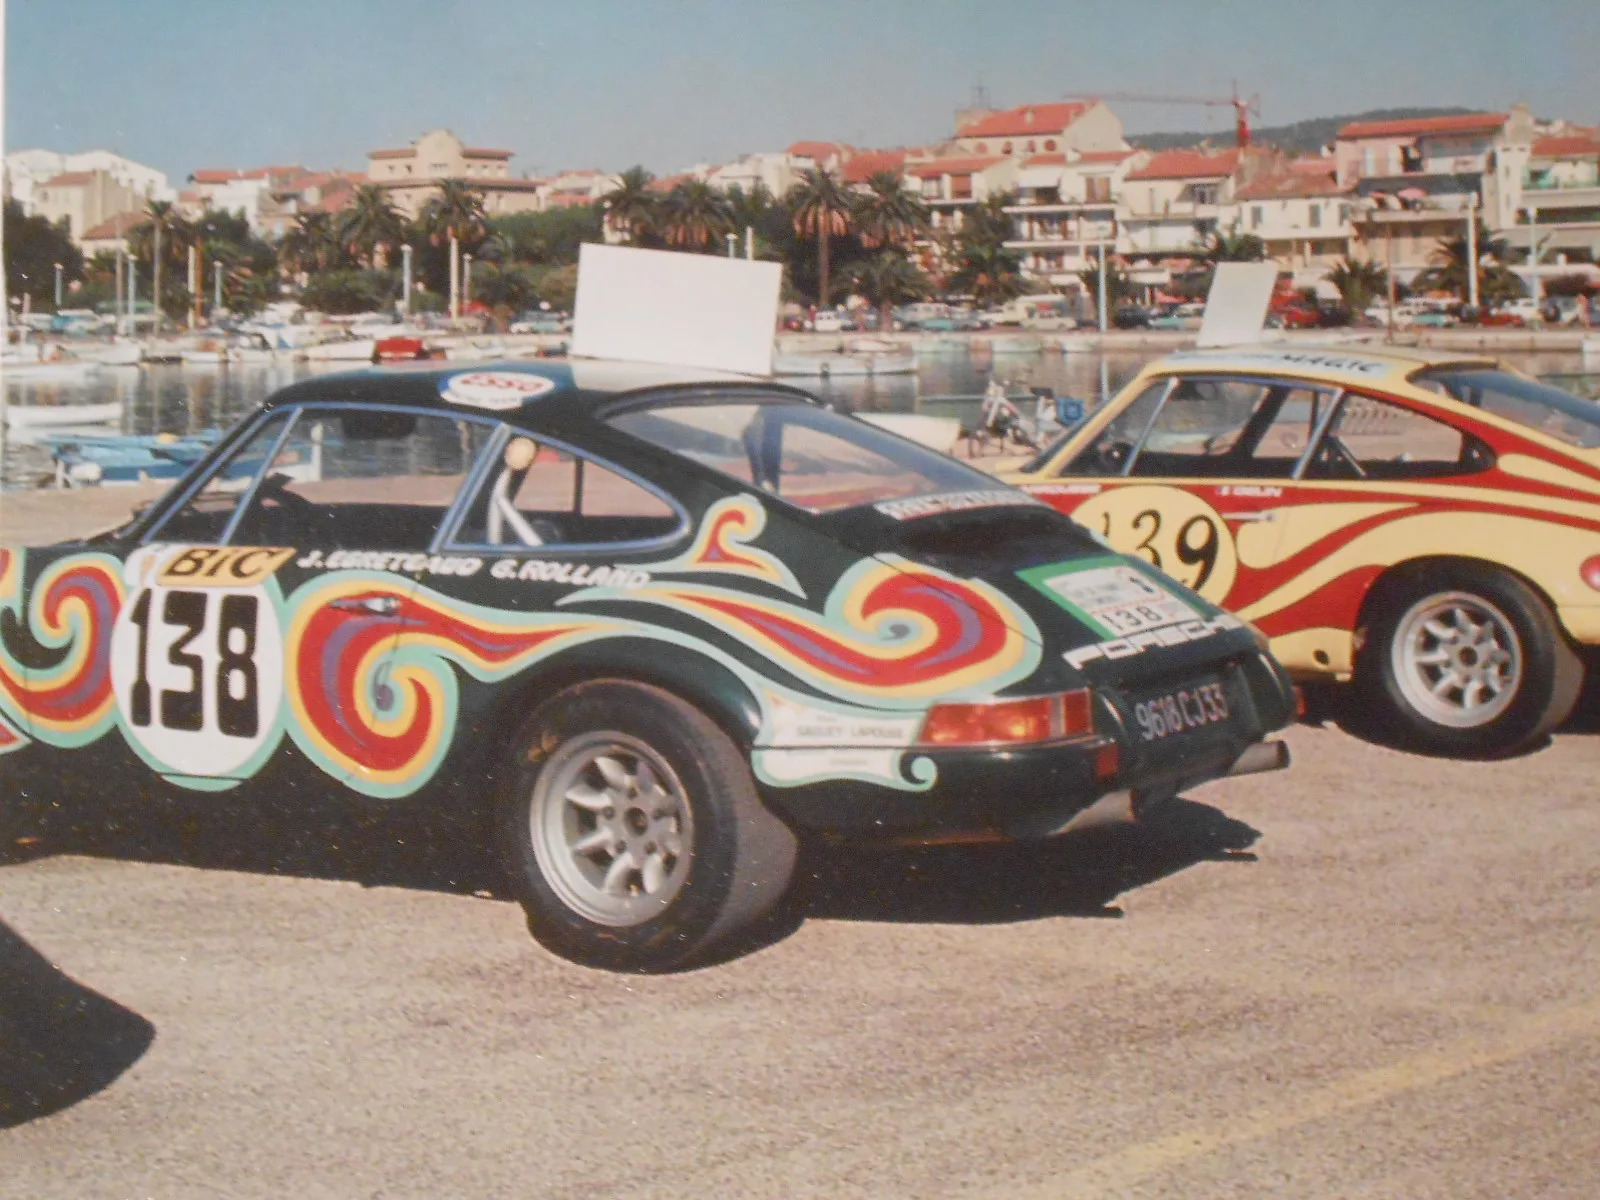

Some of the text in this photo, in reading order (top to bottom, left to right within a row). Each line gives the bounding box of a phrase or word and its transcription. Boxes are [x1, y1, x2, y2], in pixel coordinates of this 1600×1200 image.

[163, 547, 280, 579] BIC
[1101, 605, 1163, 630] 138
[129, 588, 260, 738] 138
